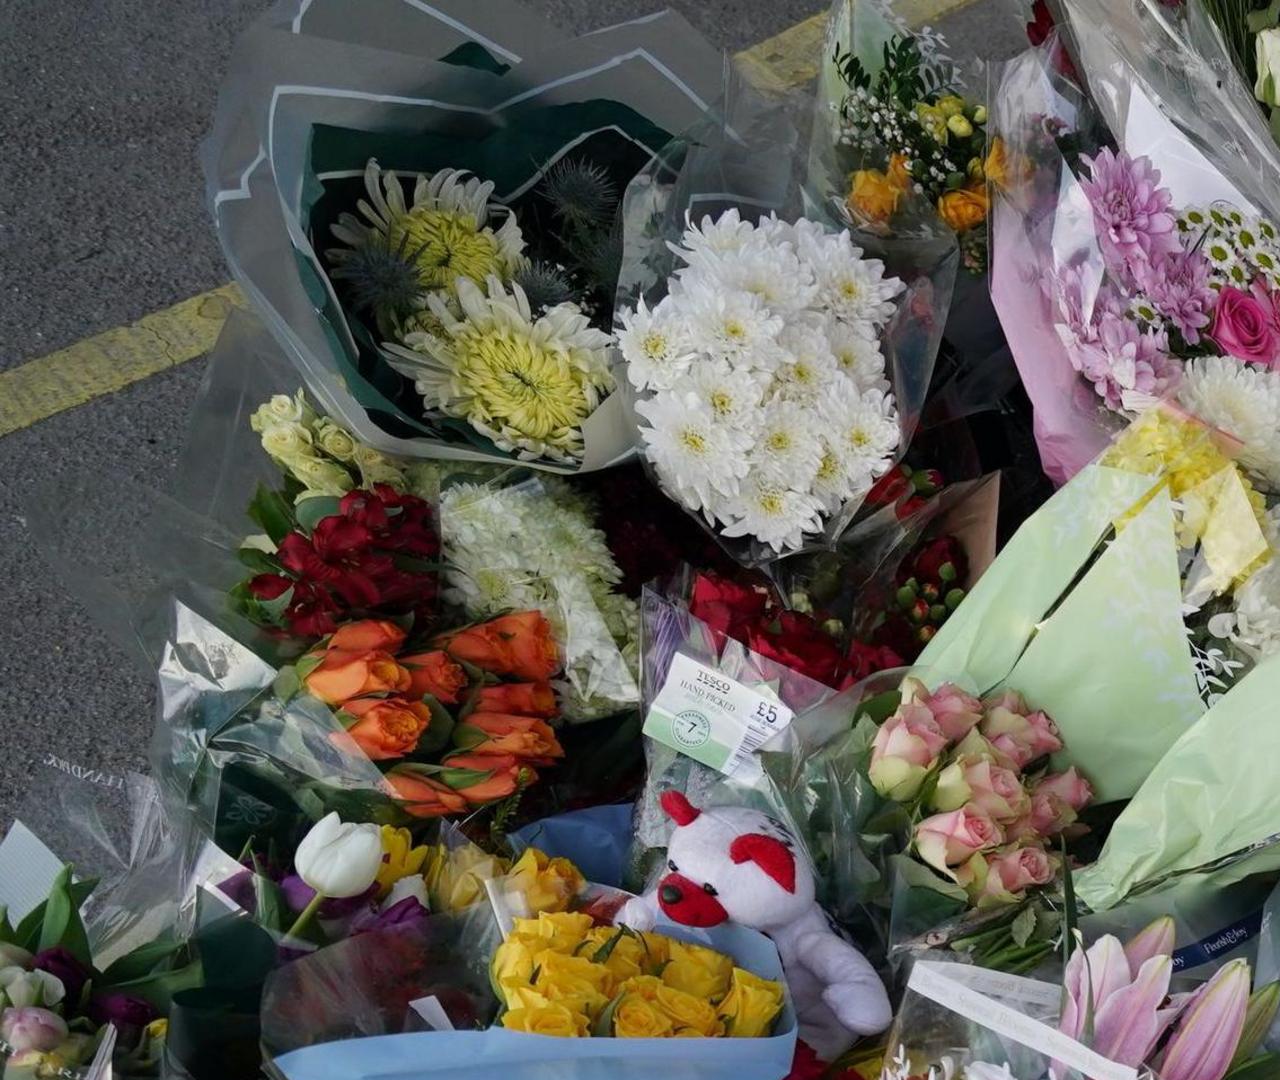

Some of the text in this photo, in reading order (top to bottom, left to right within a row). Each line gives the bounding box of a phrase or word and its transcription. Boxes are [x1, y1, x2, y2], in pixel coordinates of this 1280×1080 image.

[697, 670, 731, 692] TESCO
[705, 695, 736, 713] PICKED
[756, 701, 778, 724] £5
[687, 721, 697, 733] 7
